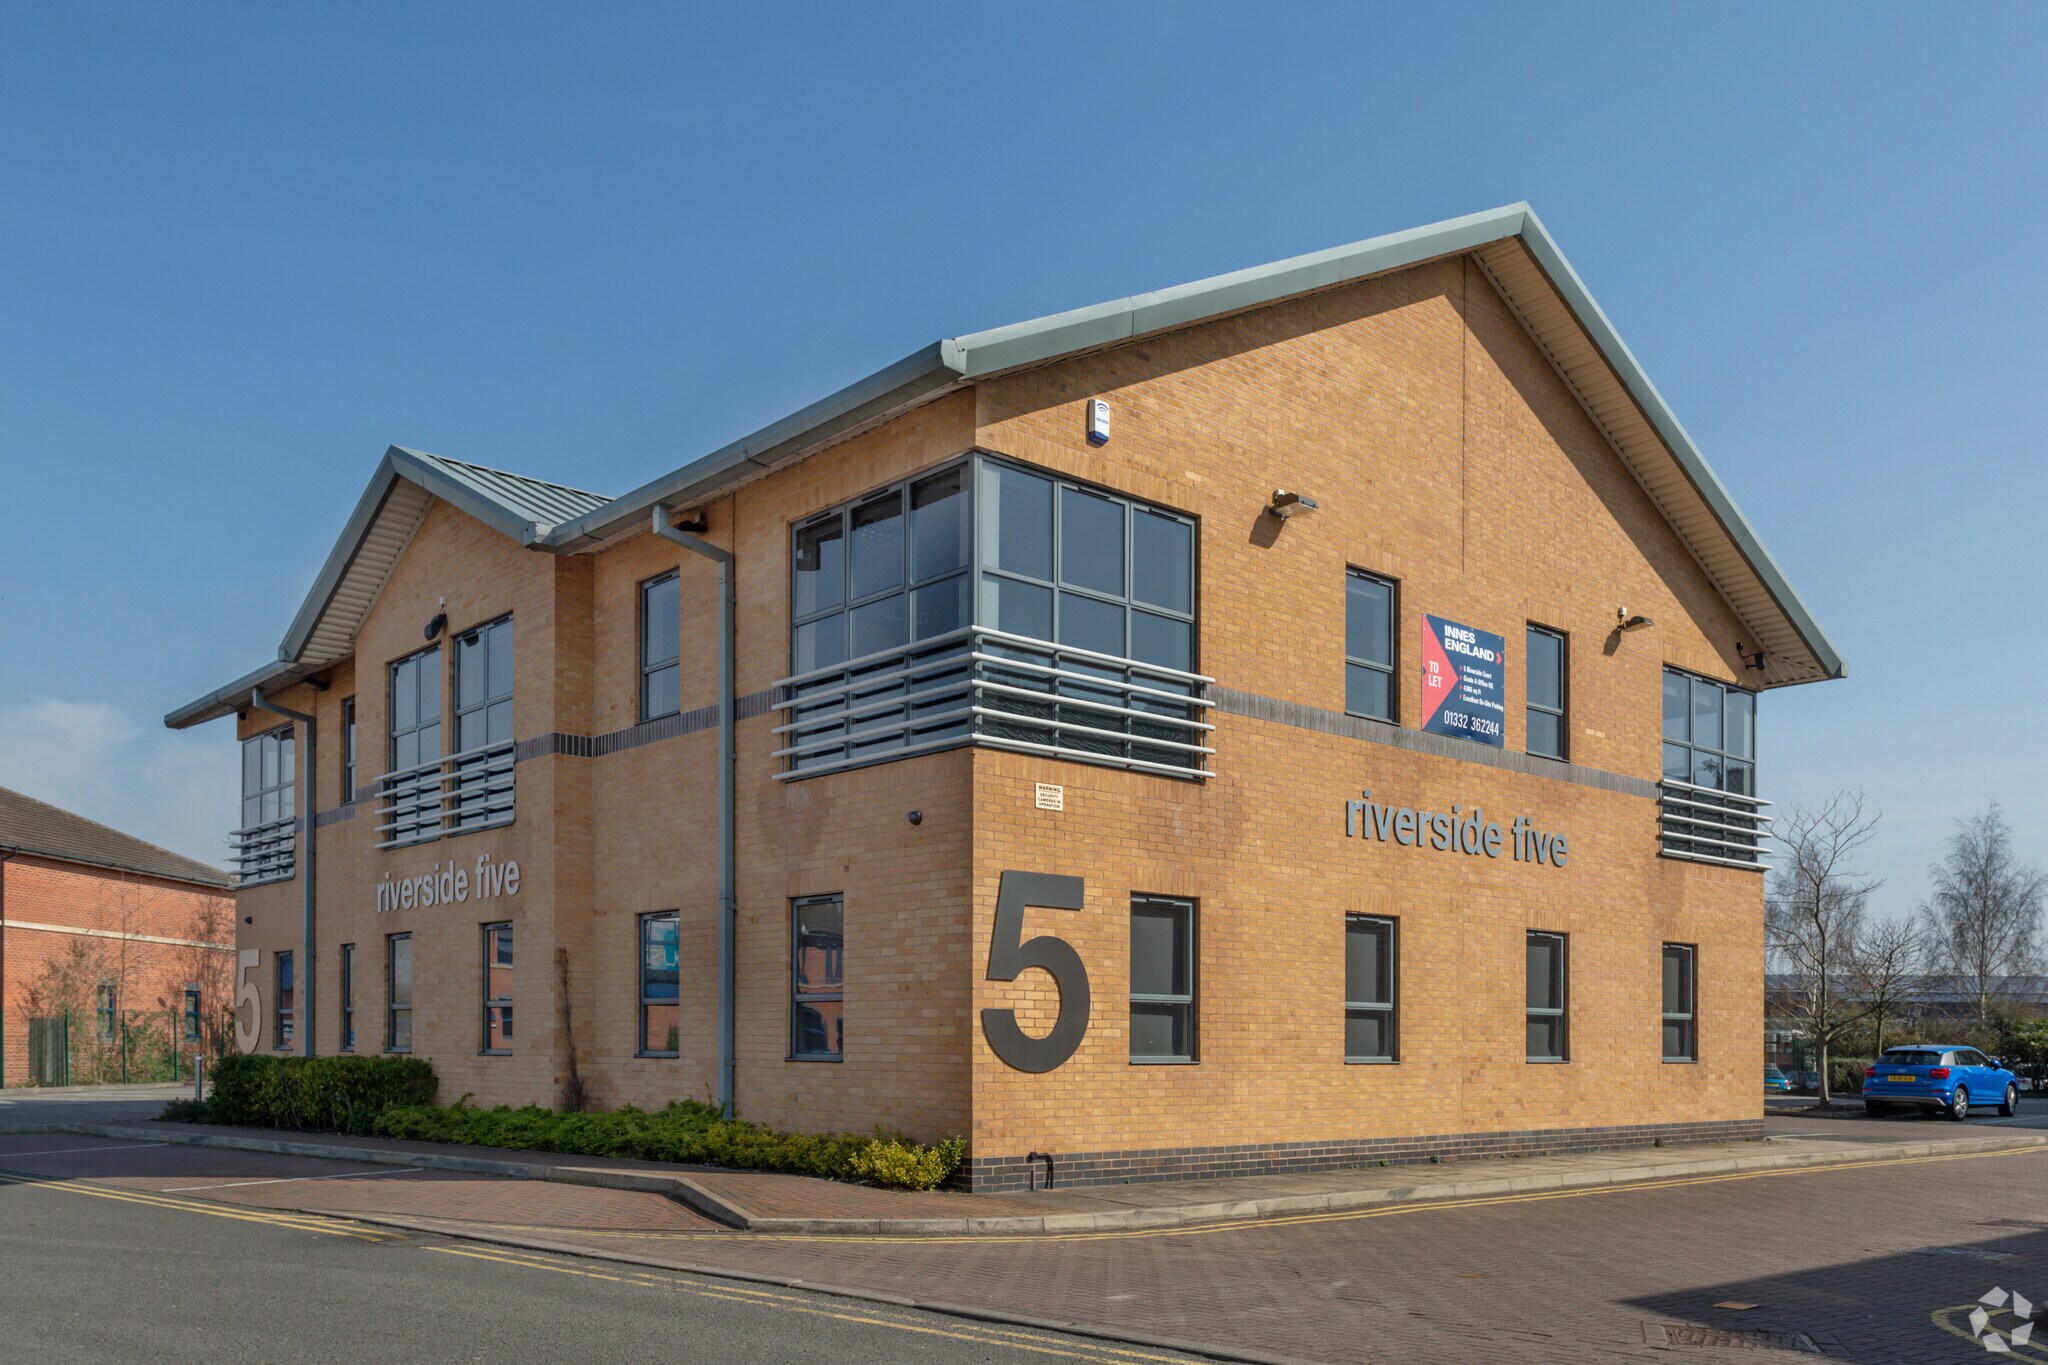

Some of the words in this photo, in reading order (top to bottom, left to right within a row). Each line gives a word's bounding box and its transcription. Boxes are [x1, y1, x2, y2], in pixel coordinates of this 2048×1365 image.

[1445, 625, 1475, 643] INNES
[1445, 638, 1494, 661] ENGLAND
[1429, 661, 1439, 673] TO
[1467, 666, 1482, 676] Riverside
[1429, 675, 1442, 688] LET
[1464, 675, 1473, 683] Grade
[1463, 694, 1478, 704] Excellent
[1492, 702, 1504, 712] Parking
[1444, 711, 1468, 728] 01332
[1471, 717, 1499, 735] 362244
[1346, 789, 1503, 858] riverside
[1511, 816, 1569, 868] five
[377, 861, 469, 913] riverside
[475, 854, 521, 899] five
[981, 870, 1090, 1074] 5
[235, 948, 262, 1055] 5
